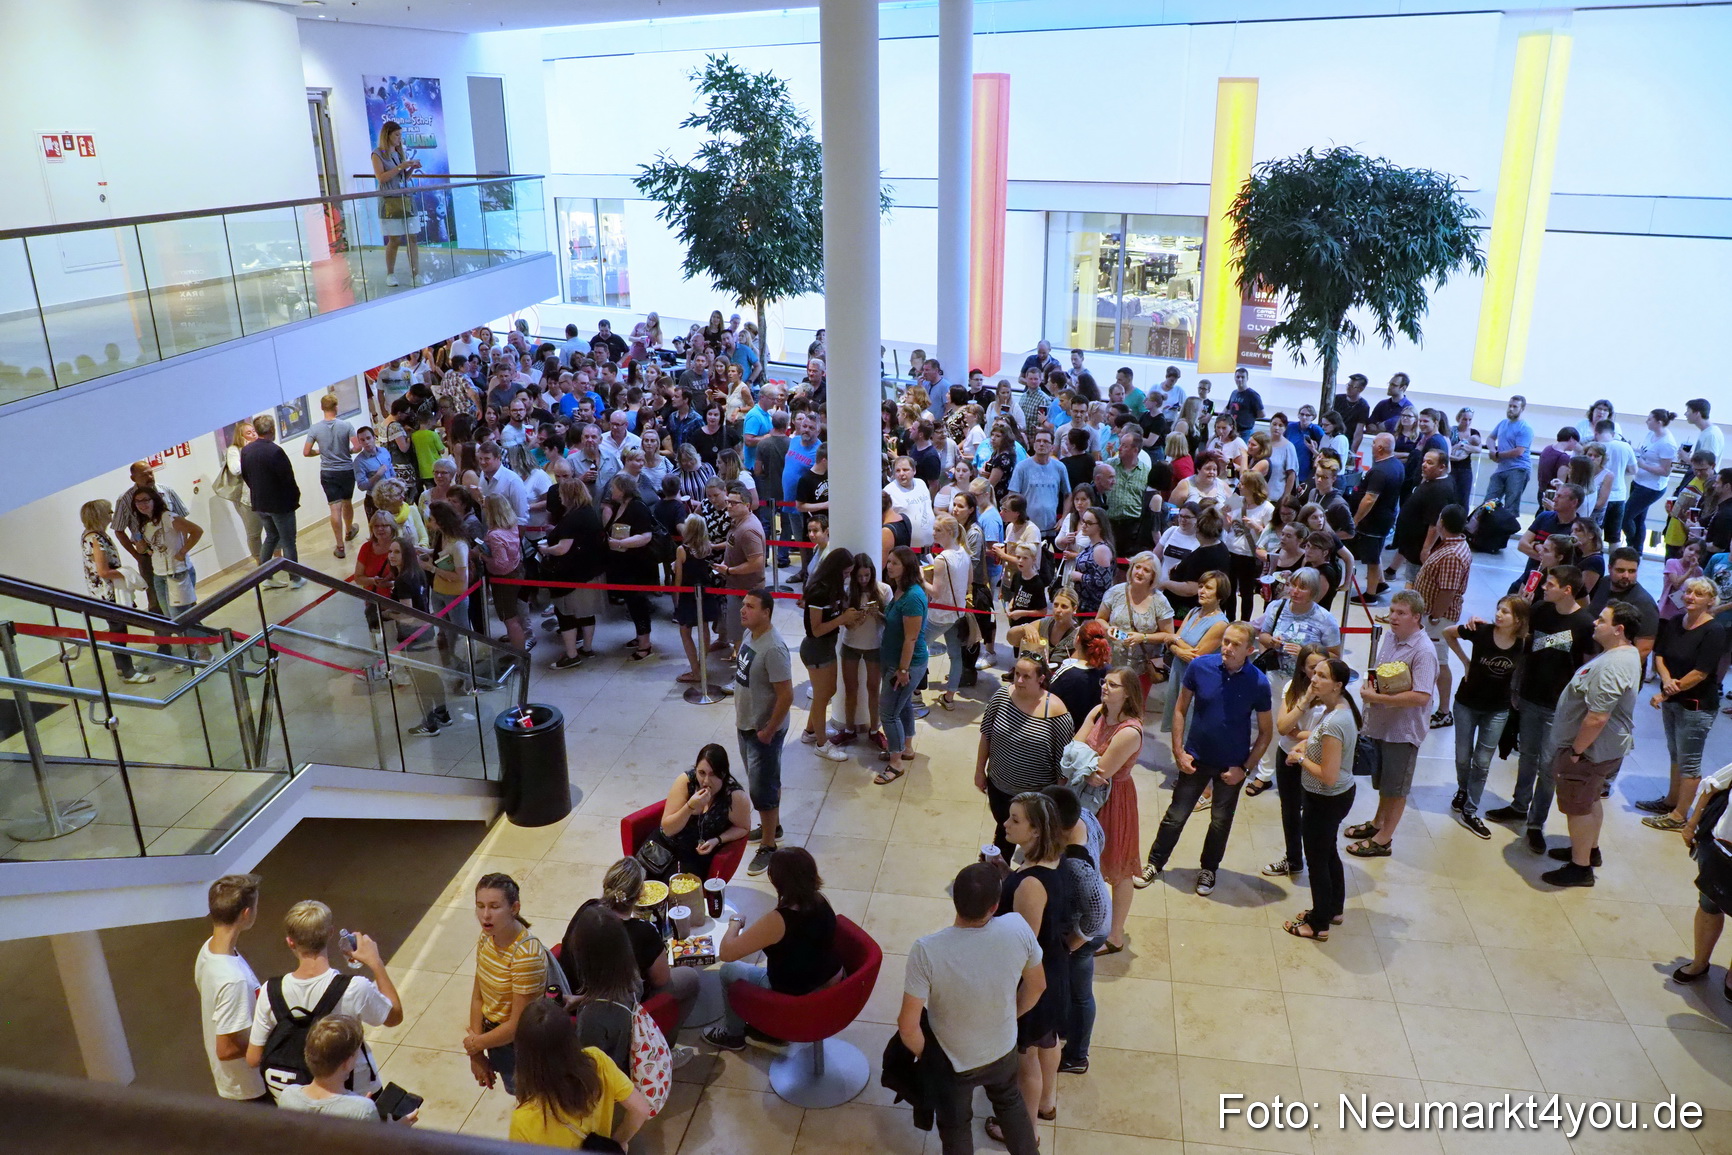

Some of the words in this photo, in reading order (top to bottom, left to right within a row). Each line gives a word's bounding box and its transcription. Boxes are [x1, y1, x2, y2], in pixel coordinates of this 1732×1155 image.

[411, 116, 433, 126] Schaf
[1241, 351, 1262, 359] GERRY
[1479, 657, 1502, 666] Hard
